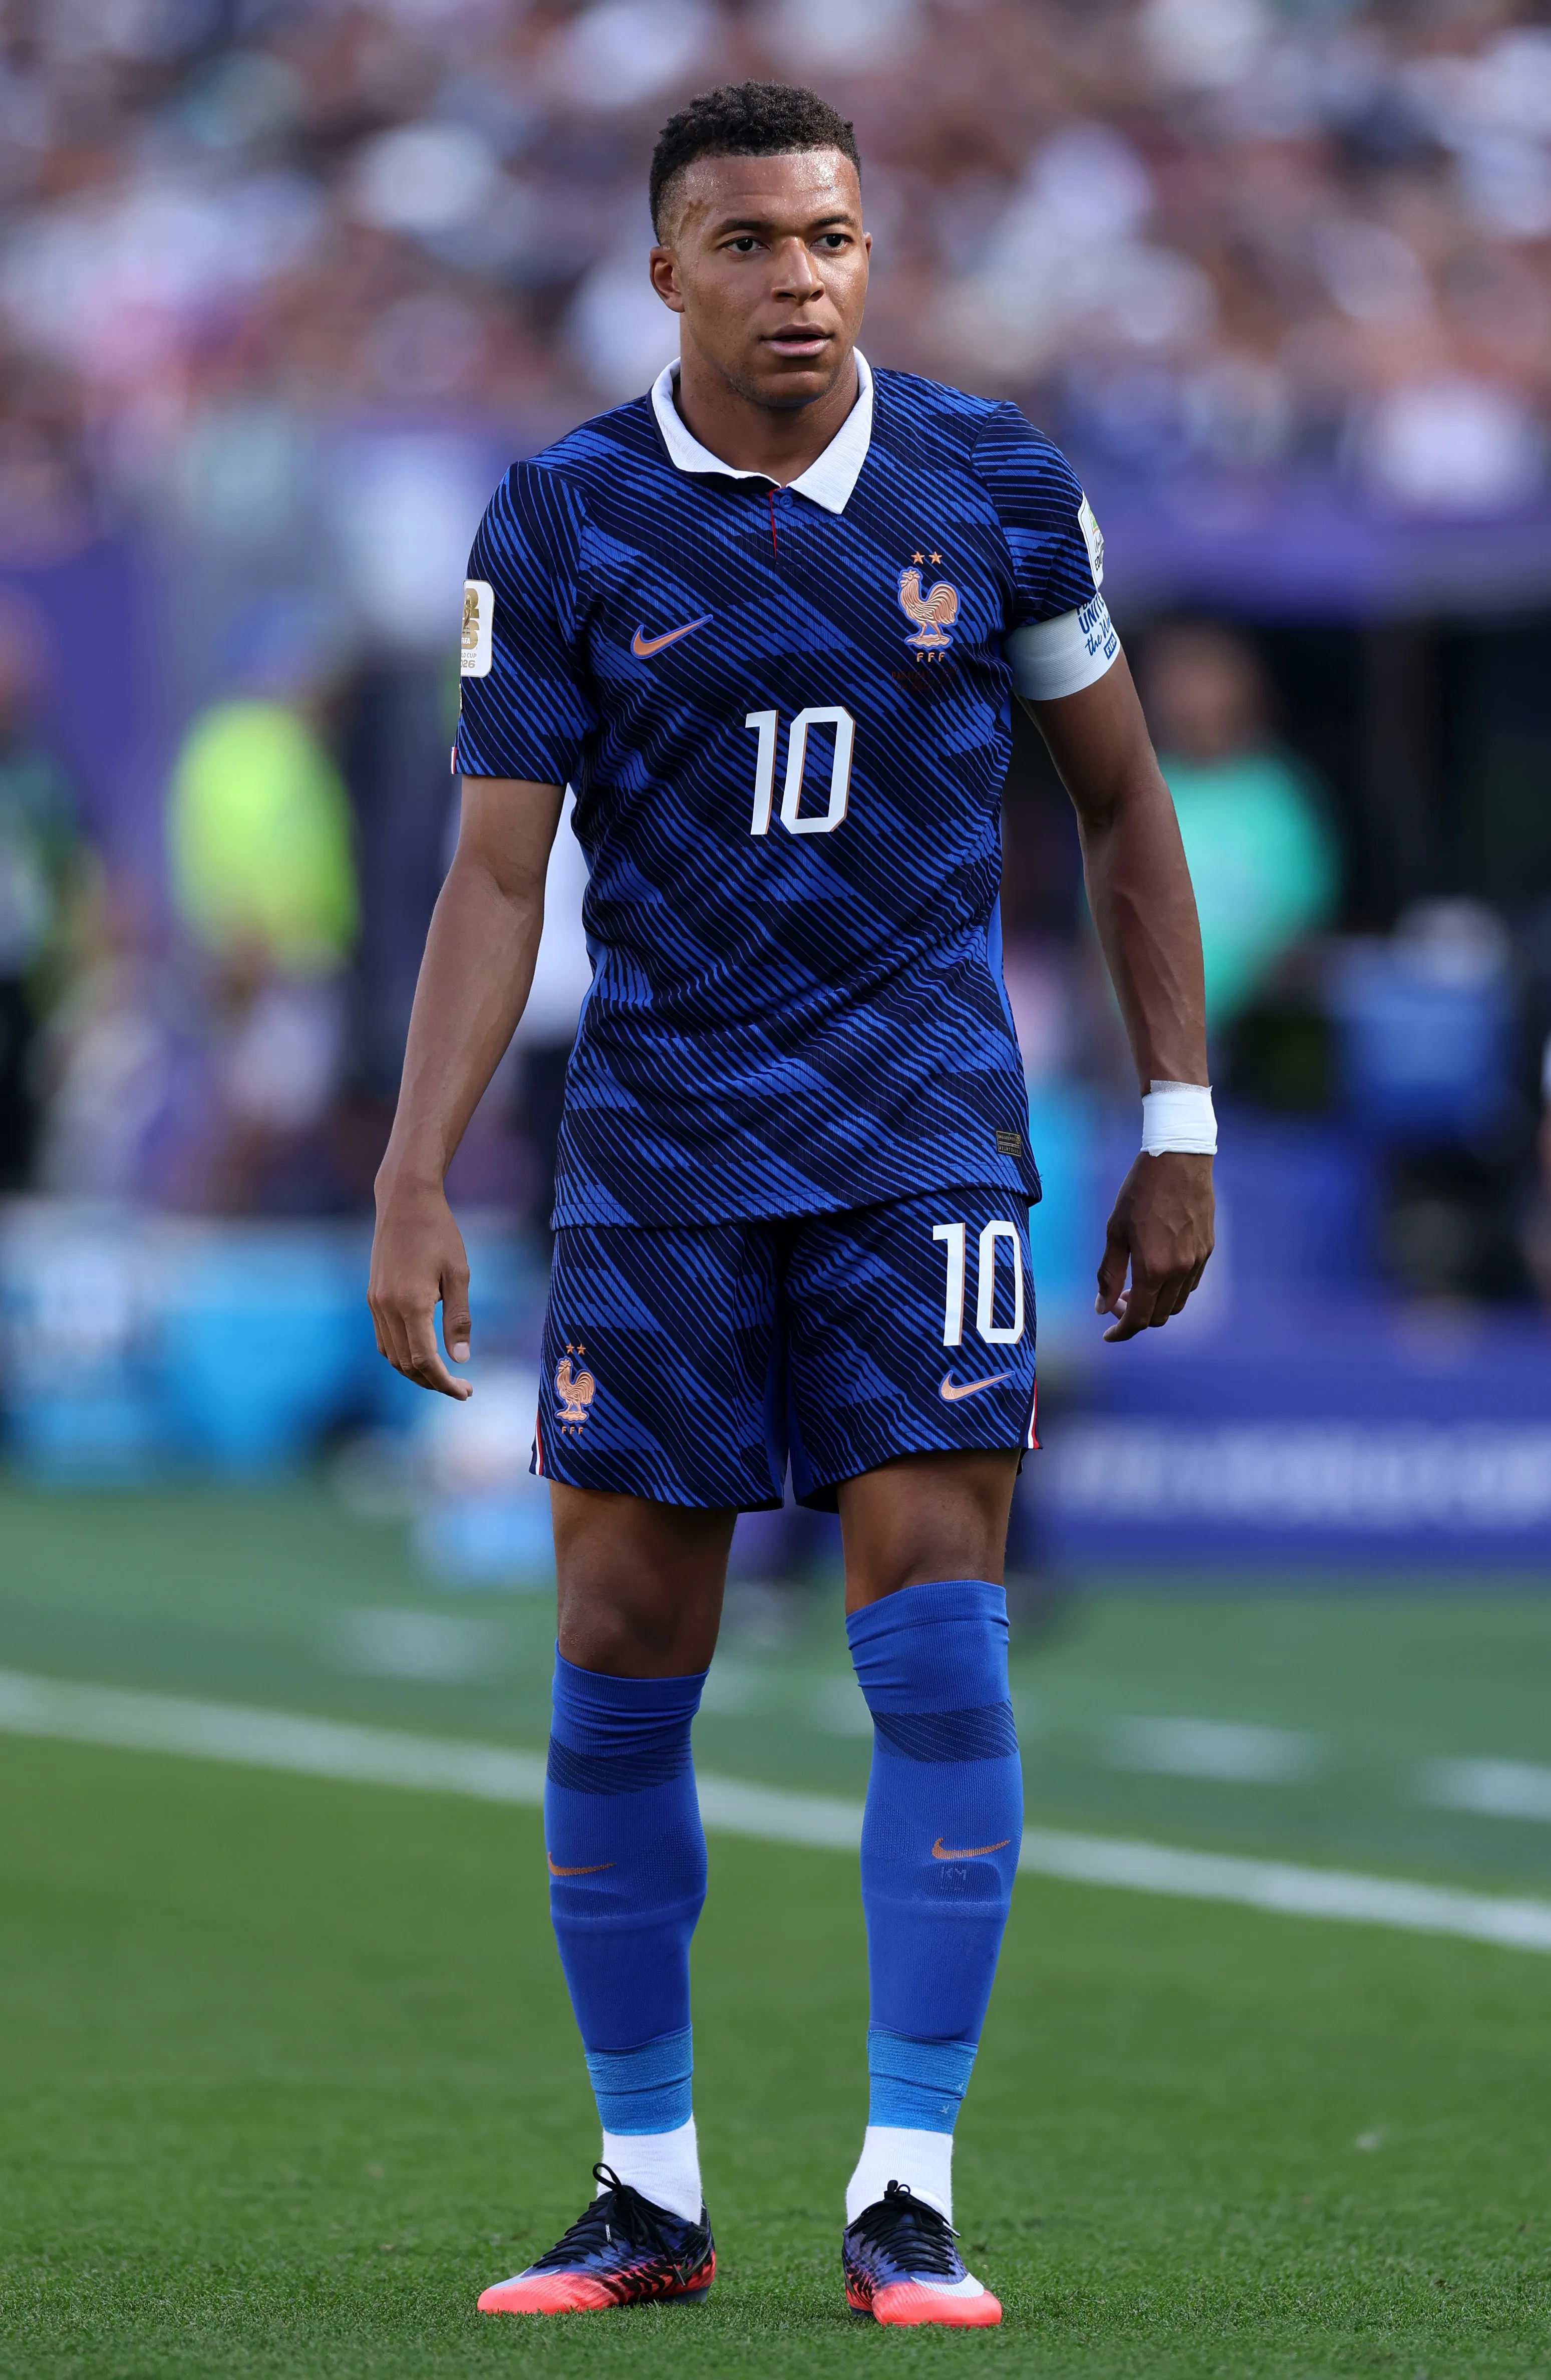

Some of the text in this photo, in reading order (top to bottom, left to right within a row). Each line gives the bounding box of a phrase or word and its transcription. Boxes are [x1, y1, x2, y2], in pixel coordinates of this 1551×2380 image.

[1084, 633, 1102, 656] the
[1105, 635, 1116, 657] FIFA
[461, 659, 476, 669] 026
[745, 706, 856, 835] 10
[933, 1220, 1025, 1346] 10
